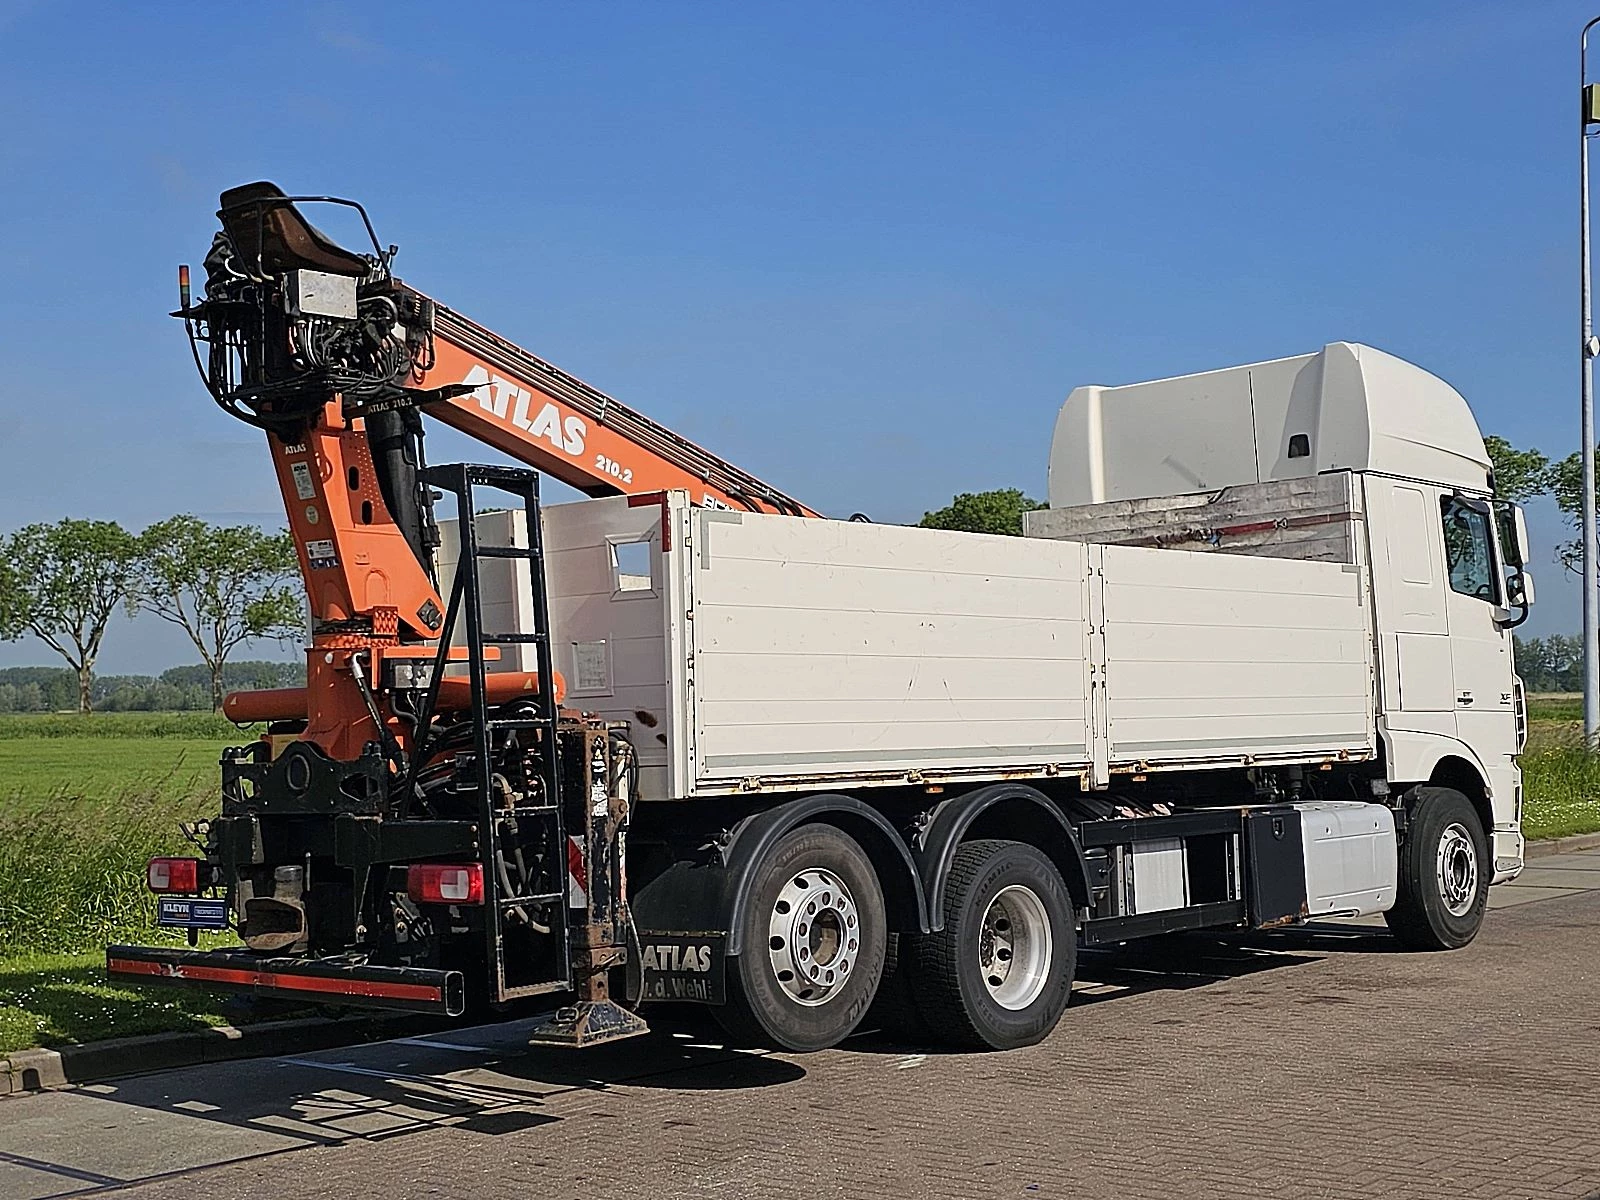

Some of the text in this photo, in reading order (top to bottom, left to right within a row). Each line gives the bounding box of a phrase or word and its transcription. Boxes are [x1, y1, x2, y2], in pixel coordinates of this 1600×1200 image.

[367, 396, 414, 415] ATLAS 210.2
[460, 364, 633, 485] ATLAS 210.2
[285, 443, 307, 455] ATLAS
[643, 945, 711, 972] ATLAS
[671, 977, 708, 1000] Wehl
